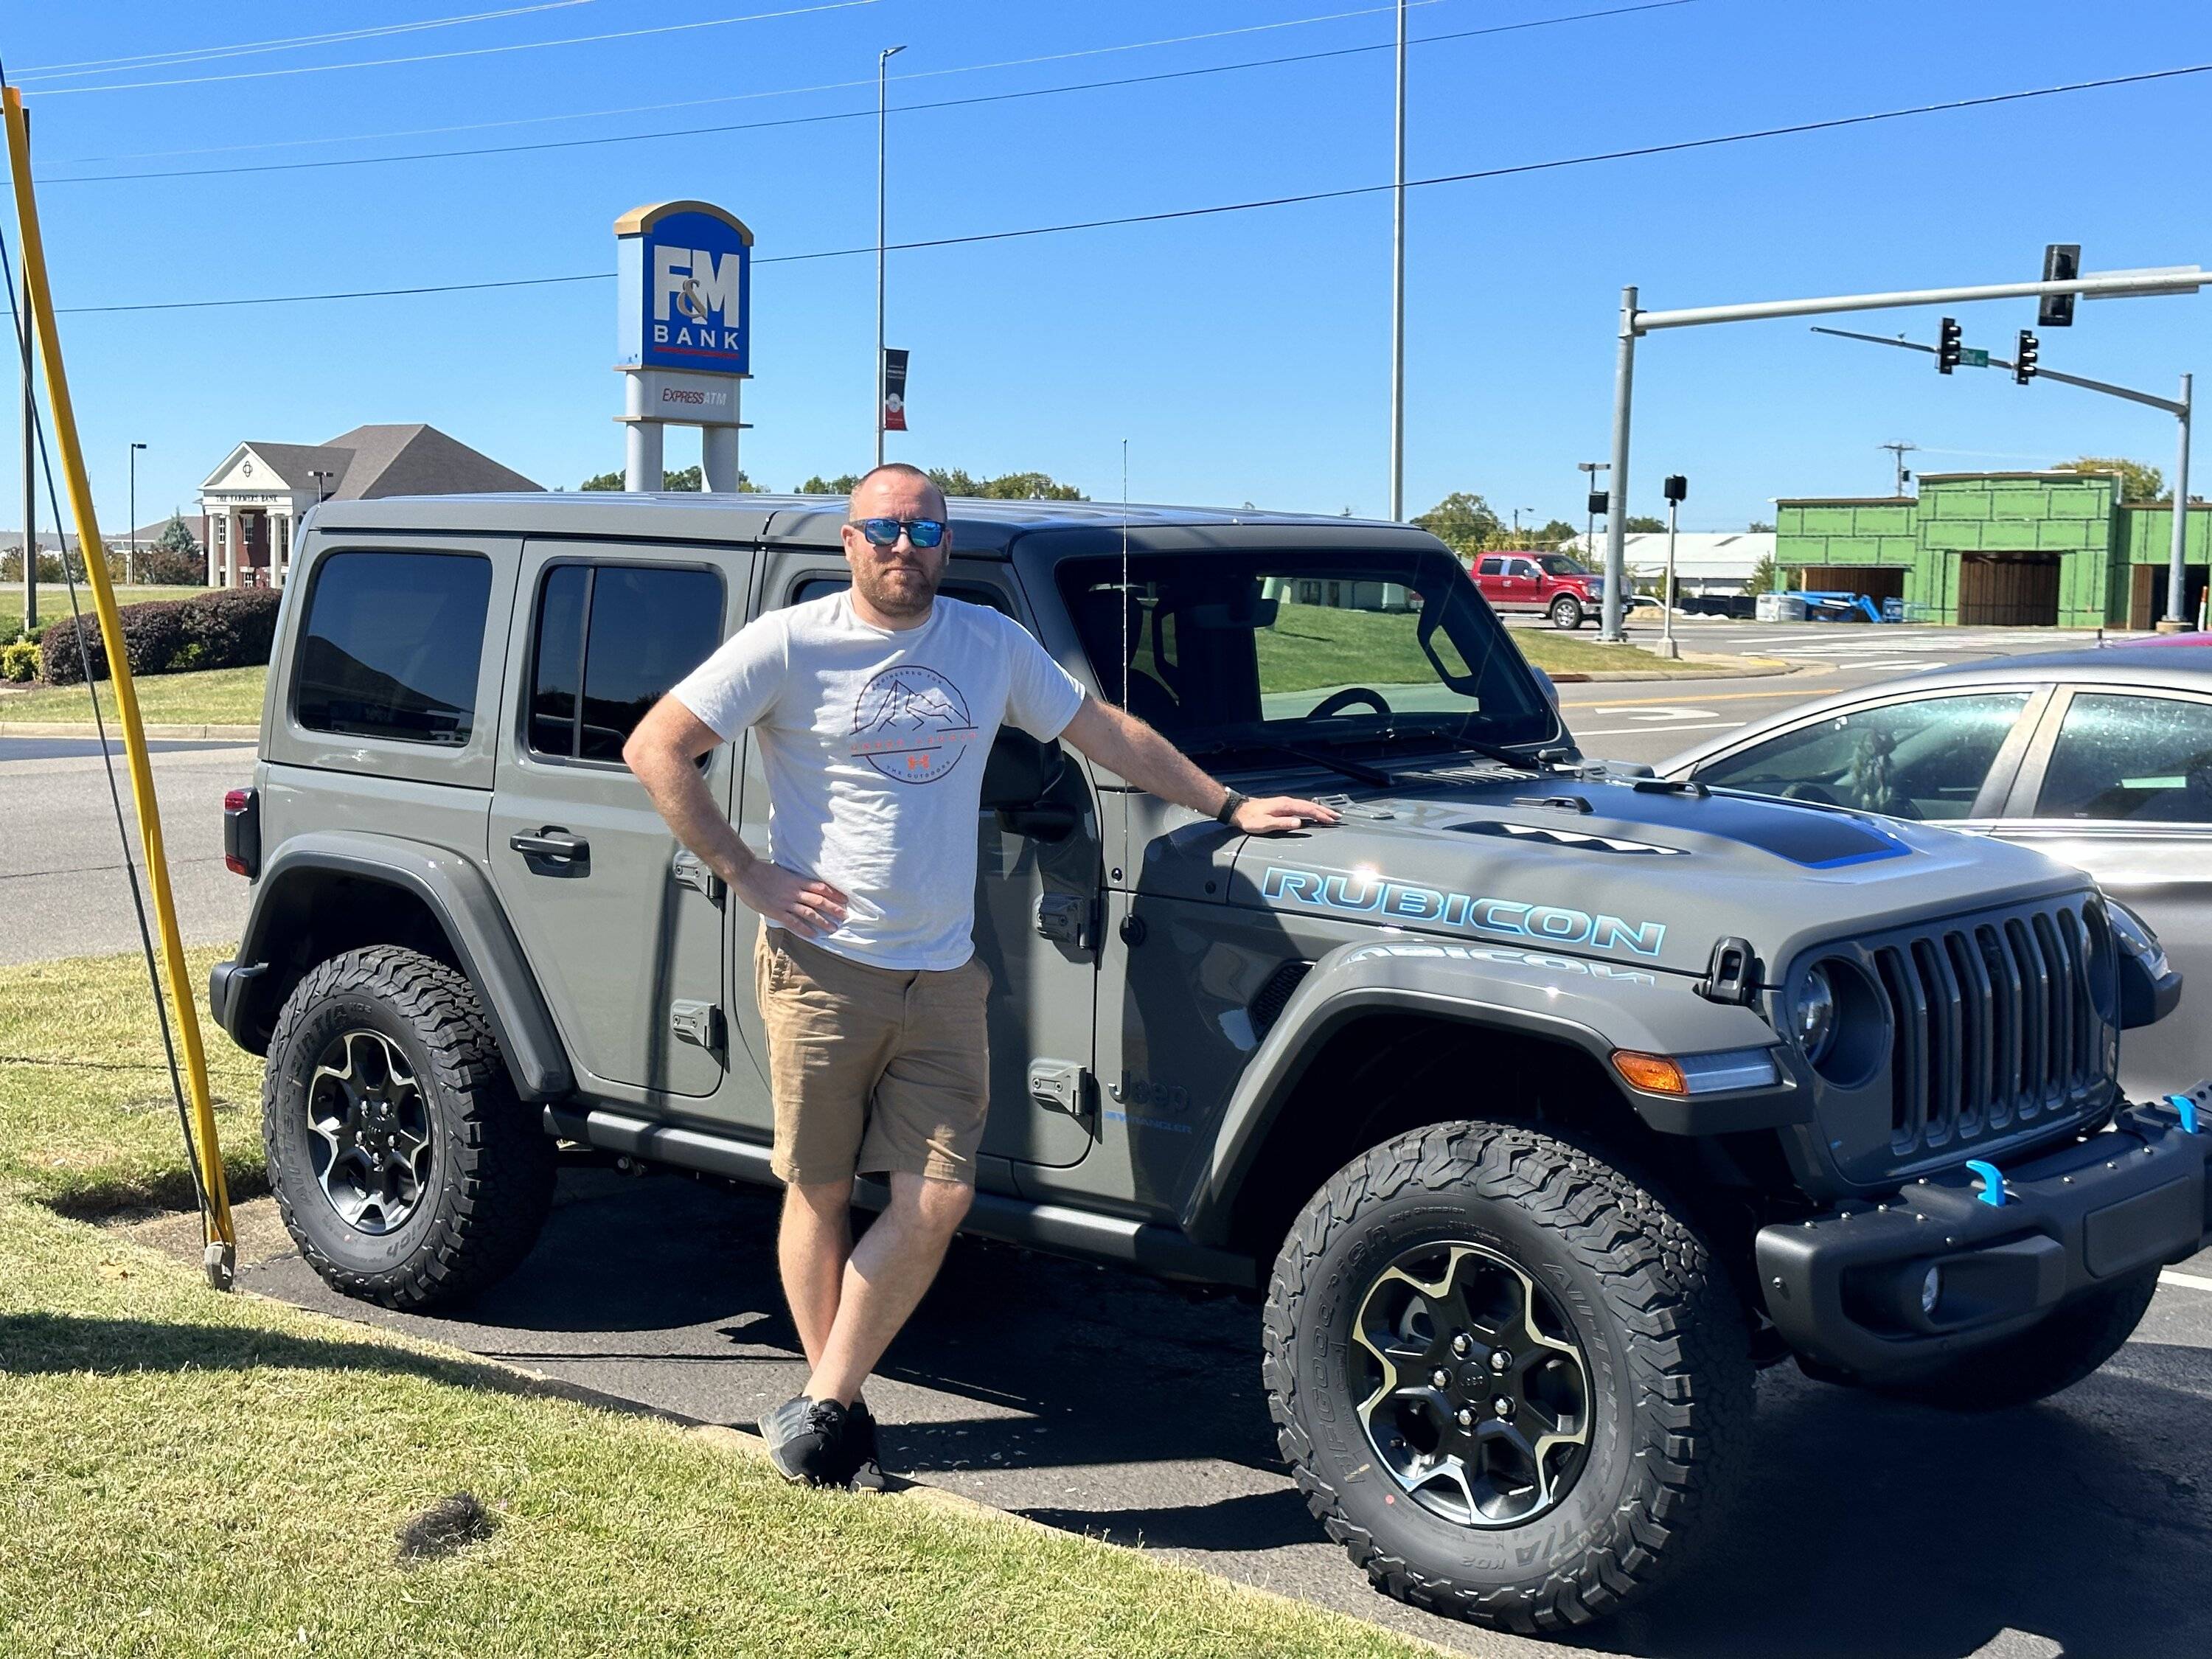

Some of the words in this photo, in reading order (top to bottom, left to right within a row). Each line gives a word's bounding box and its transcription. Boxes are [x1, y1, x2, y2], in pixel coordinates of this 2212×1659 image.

[654, 244, 740, 328] F&M
[654, 324, 740, 349] BANK
[662, 388, 705, 404] EXPRESS
[1262, 866, 1666, 957] RUBICON
